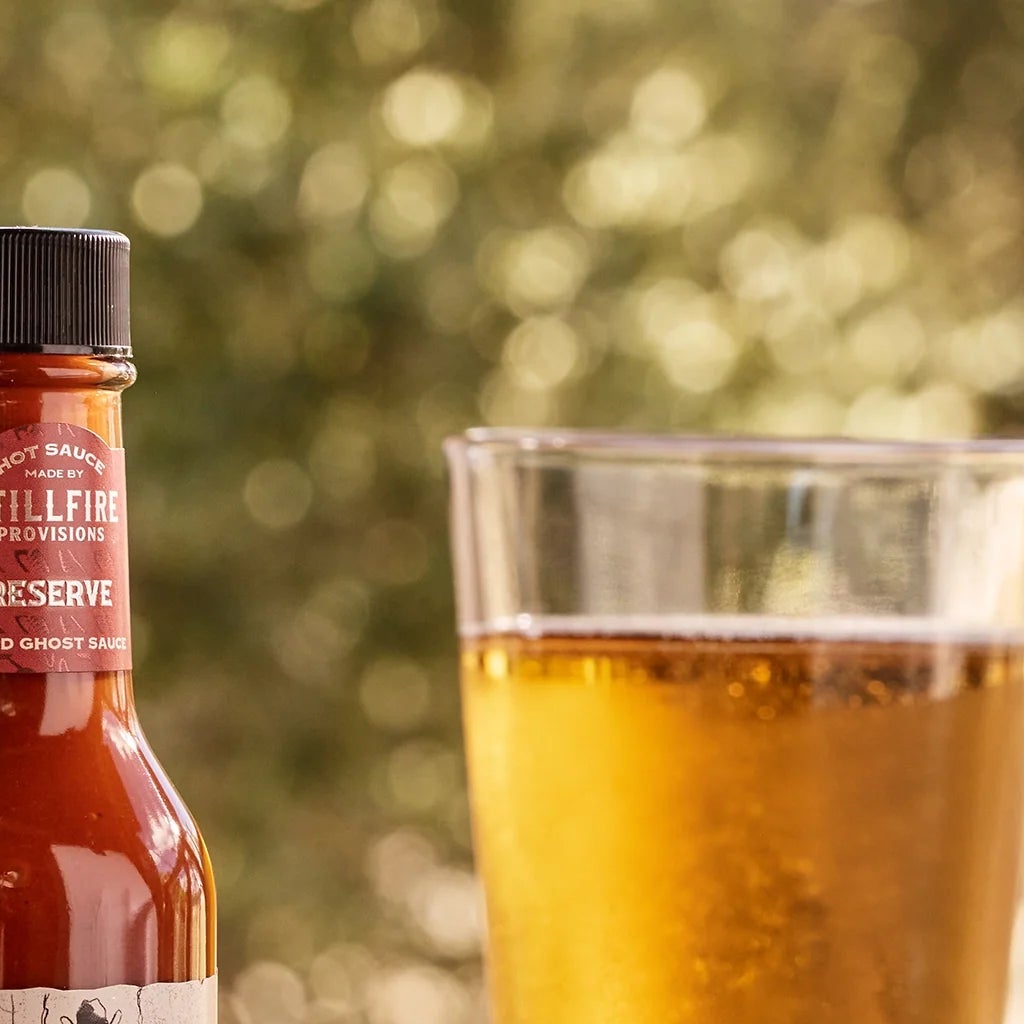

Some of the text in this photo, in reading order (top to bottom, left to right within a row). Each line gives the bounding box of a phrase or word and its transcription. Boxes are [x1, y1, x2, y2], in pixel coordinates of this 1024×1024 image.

[45, 443, 106, 475] SAUCE
[25, 469, 84, 479] MADE BY
[19, 637, 84, 650] GHOST
[88, 636, 127, 650] SAUCE
